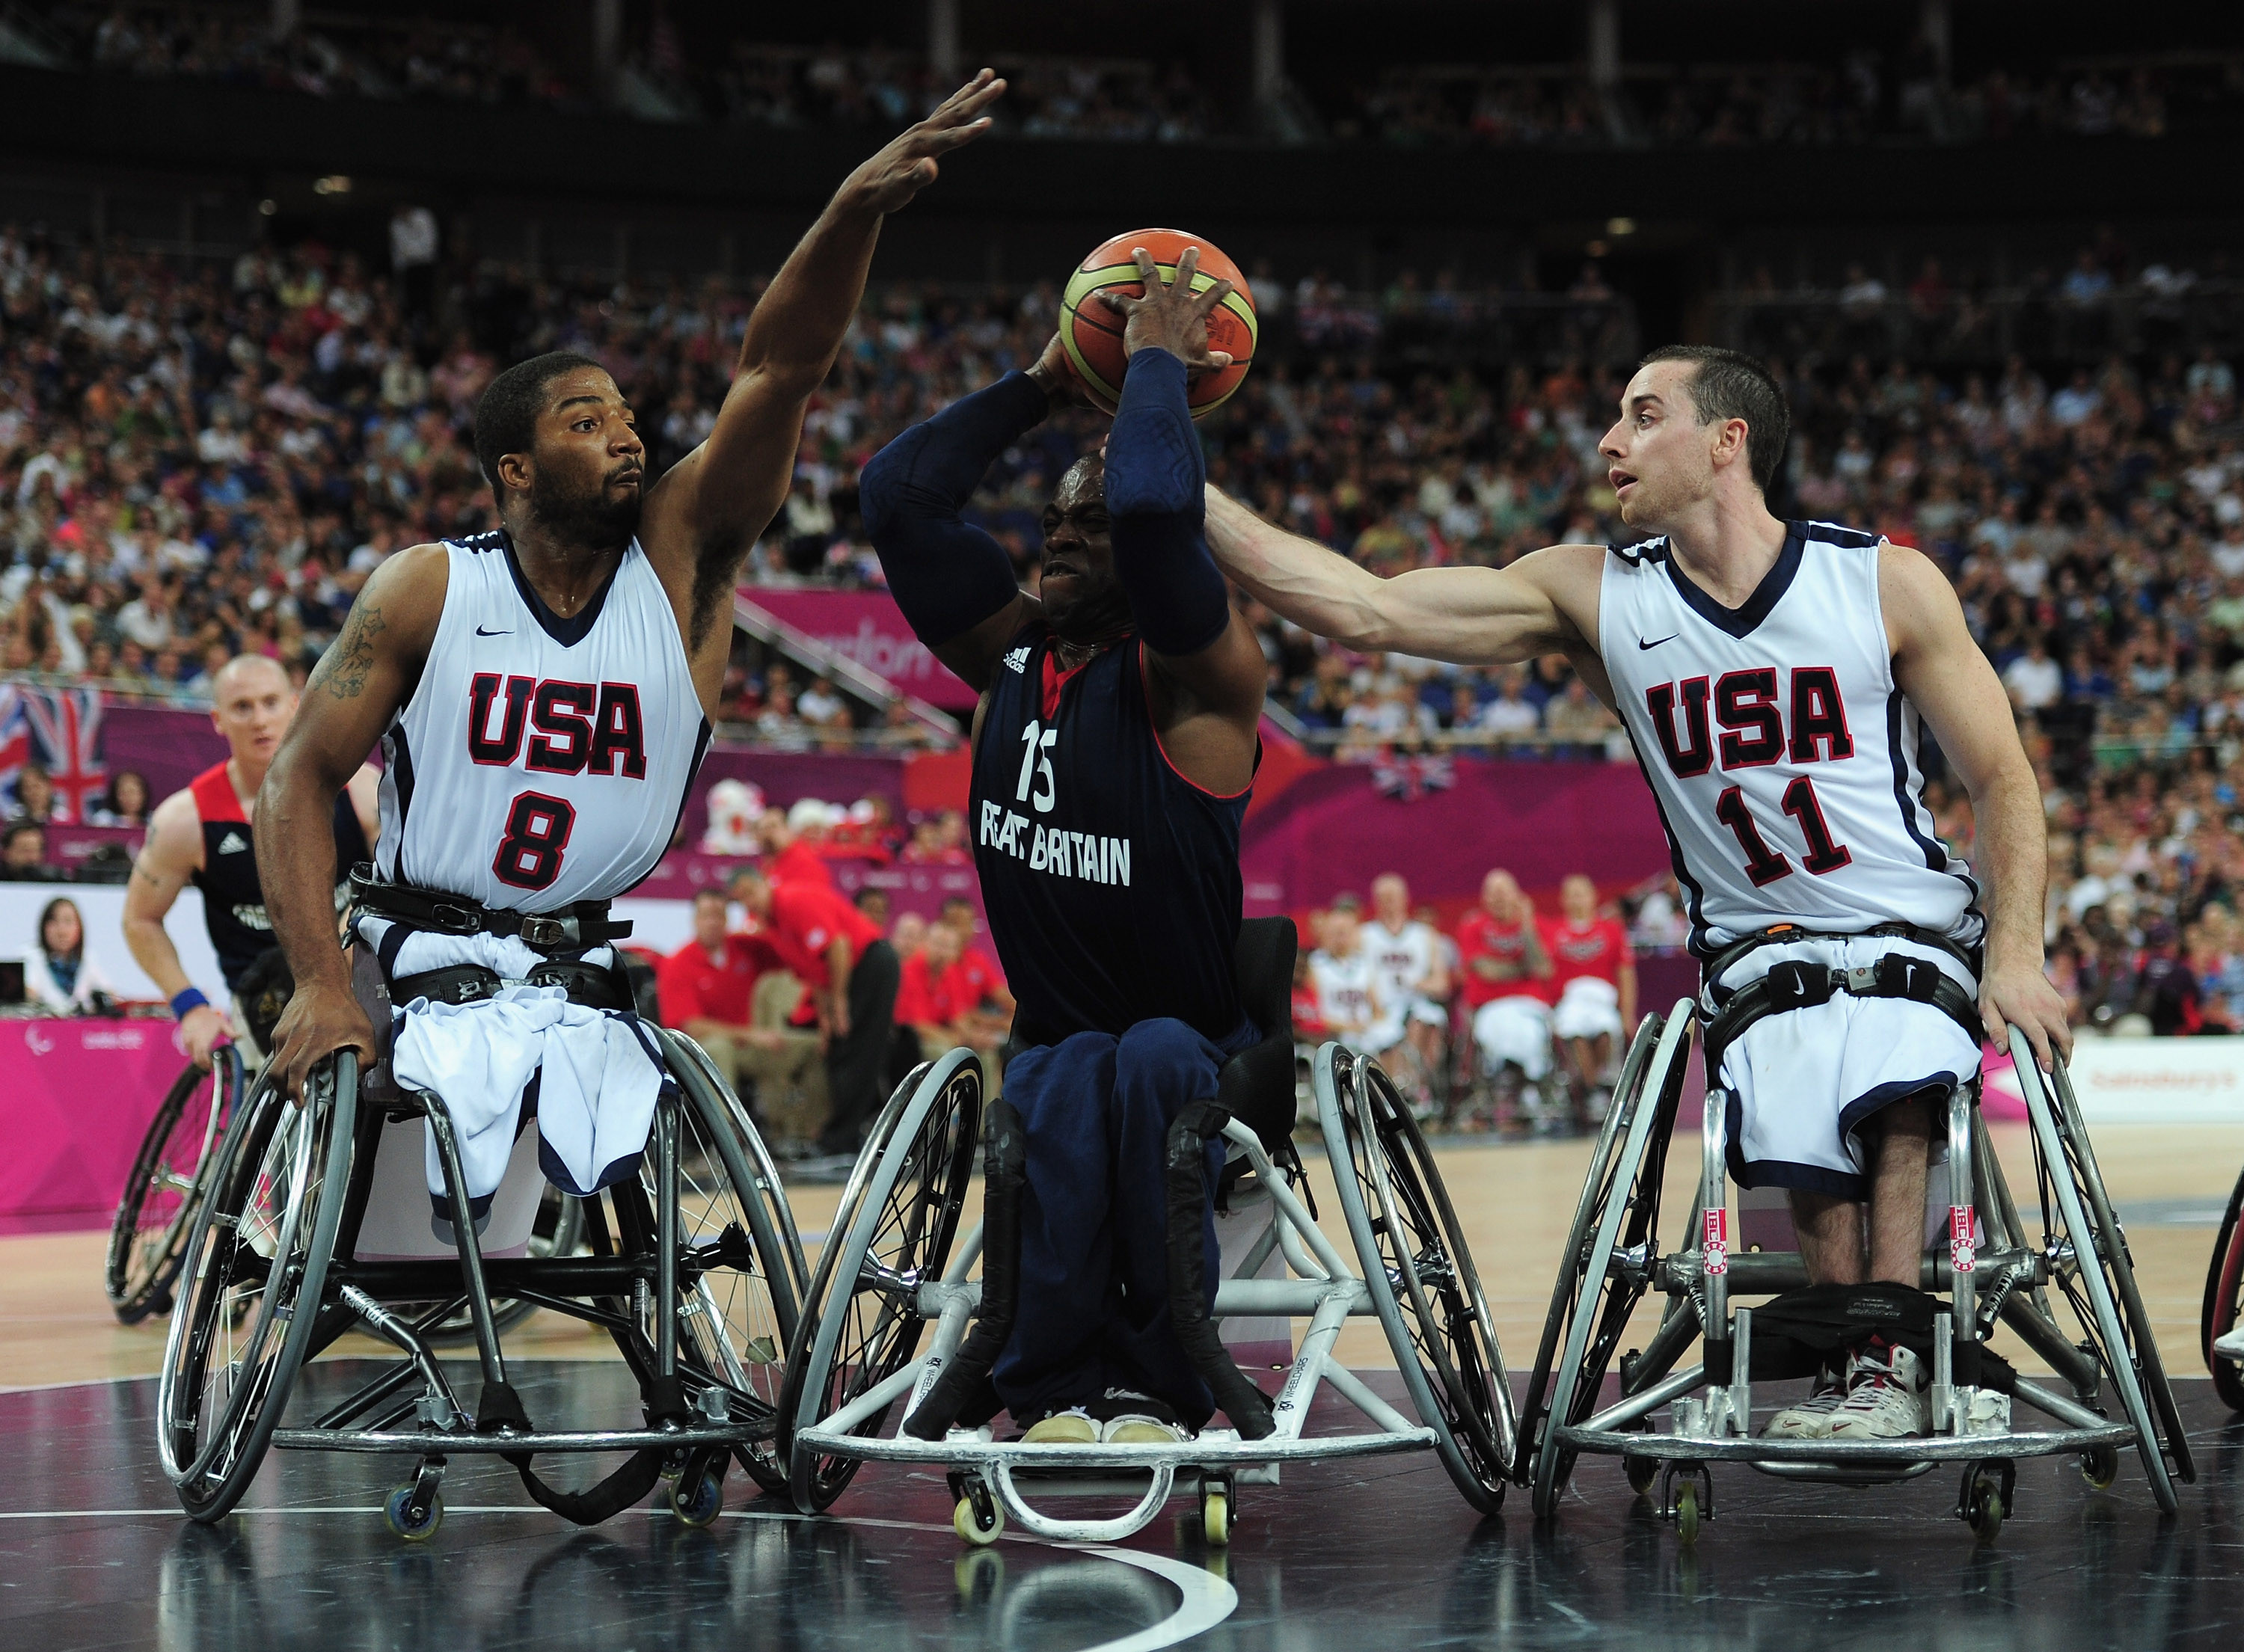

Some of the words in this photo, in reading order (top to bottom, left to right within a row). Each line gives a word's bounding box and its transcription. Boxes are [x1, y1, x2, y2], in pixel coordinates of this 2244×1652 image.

[468, 672, 646, 780] USA
[1016, 719, 1058, 813] 15
[1646, 666, 1854, 779] USA
[491, 790, 577, 891] 8
[980, 799, 1030, 860] REAT
[1029, 823, 1130, 887] BRITAIN
[1716, 775, 1854, 888] 11
[1284, 1357, 1309, 1399] WHEELCHAIRS
